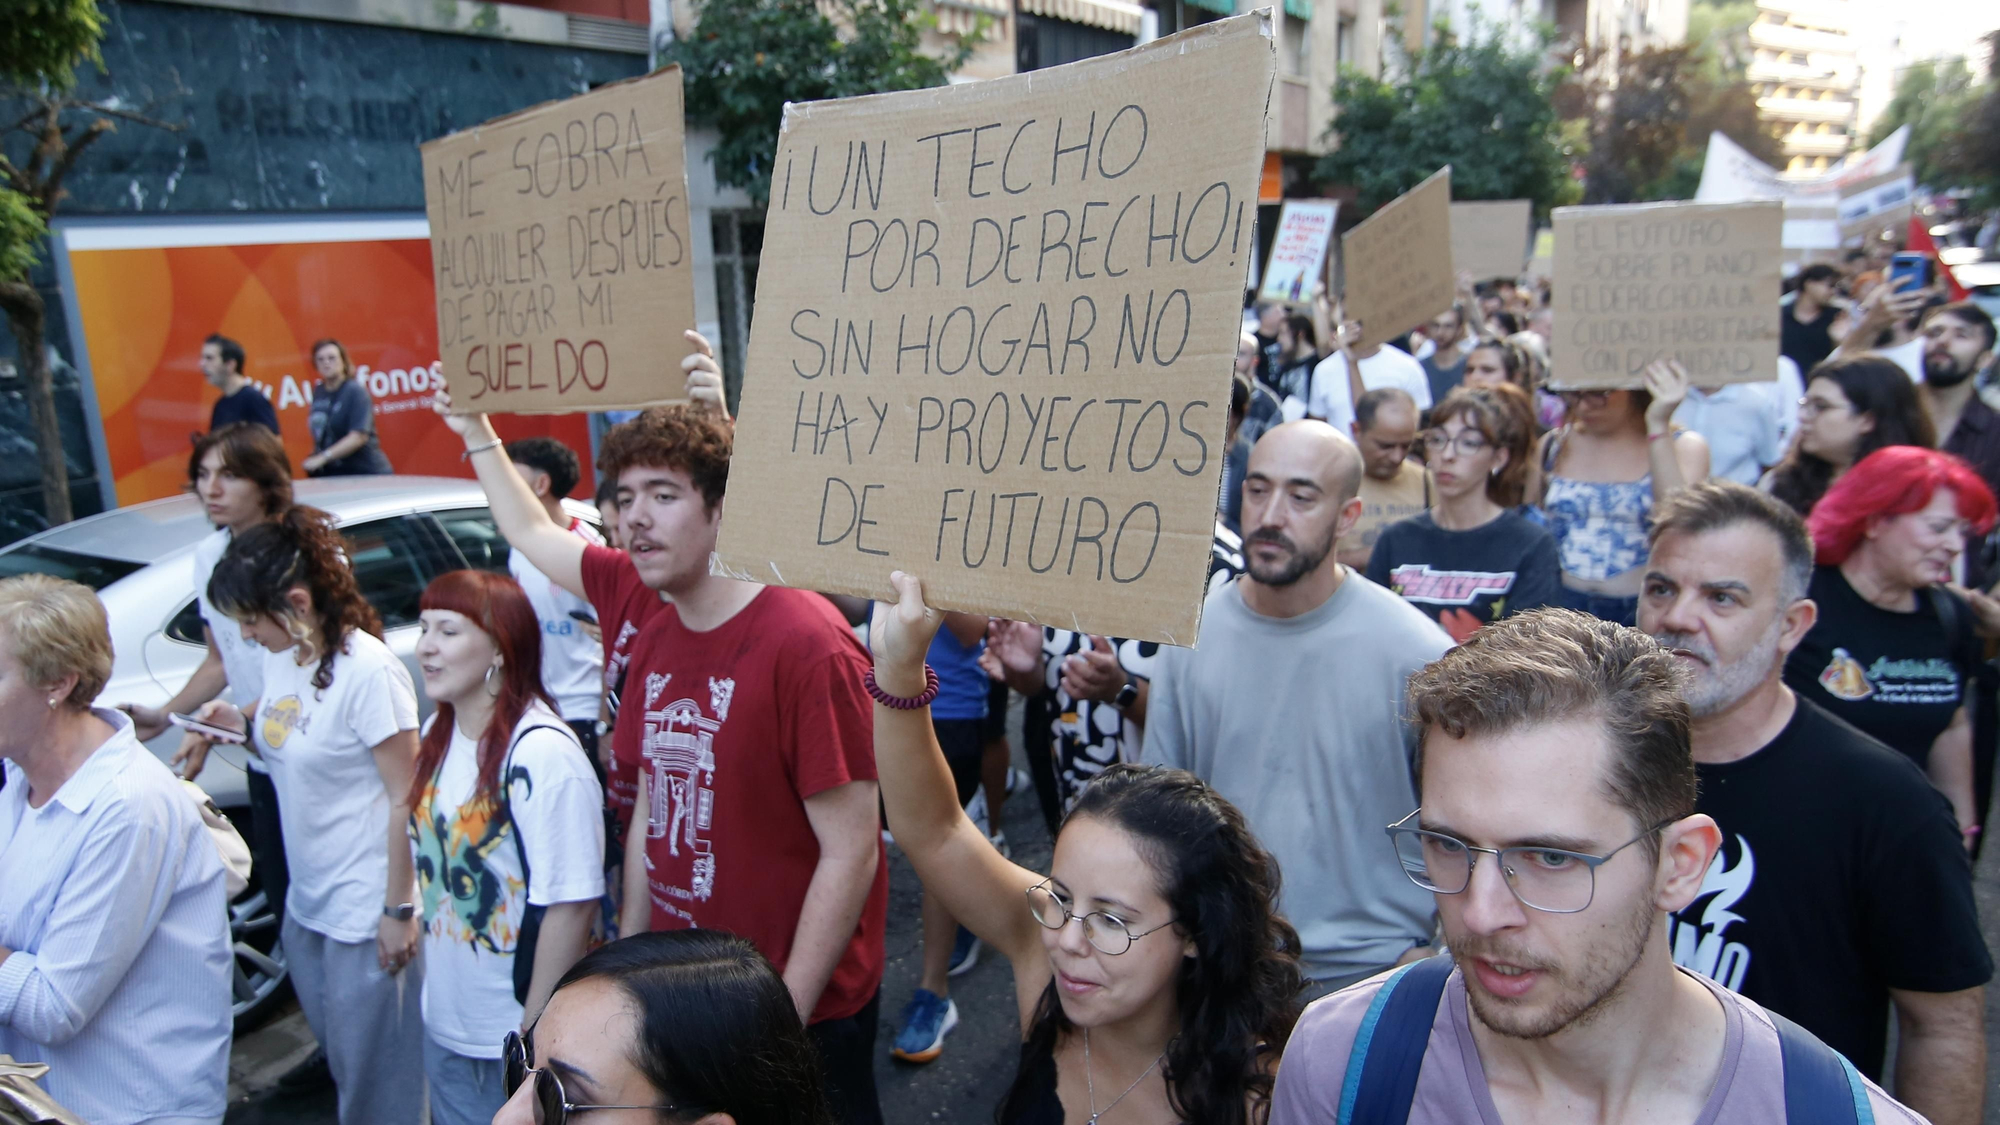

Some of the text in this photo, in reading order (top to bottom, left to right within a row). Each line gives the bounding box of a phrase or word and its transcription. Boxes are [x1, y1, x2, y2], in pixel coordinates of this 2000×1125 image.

[439, 107, 651, 230] ME SOBRA
[782, 104, 1149, 216] ¡UN TECHO
[440, 180, 684, 290] ALQUILER DESPUÉS
[842, 217, 941, 293] POR
[965, 181, 1245, 289] DERECHO!
[1574, 219, 1730, 252] EL FUTURO
[1574, 249, 1757, 281] SOBRE PLANO
[440, 279, 613, 348] DE PAGAR MI
[790, 288, 1192, 379] SIN HOGAR NO
[1572, 315, 1770, 347] CIUDAD HABITAR
[466, 338, 609, 400] SUELDO
[1581, 347, 1619, 373] CON
[792, 390, 1209, 476] HAY PROYECTOS
[817, 476, 1162, 584] DE FUTURO
